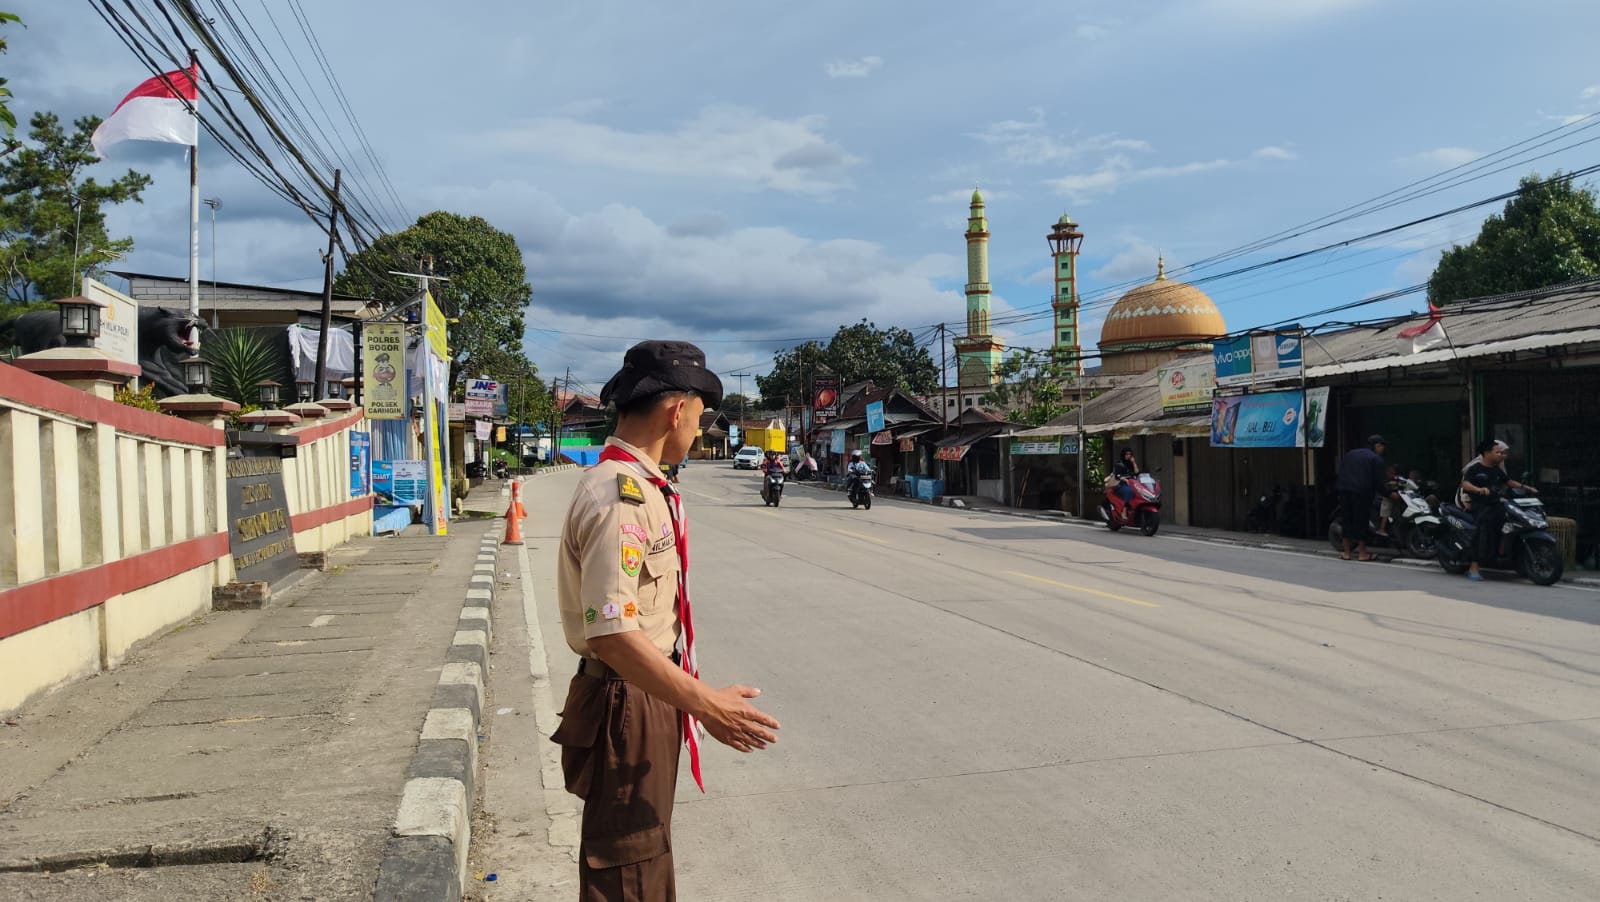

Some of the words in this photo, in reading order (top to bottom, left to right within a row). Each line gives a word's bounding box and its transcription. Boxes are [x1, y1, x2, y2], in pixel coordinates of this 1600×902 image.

[367, 336, 400, 344] POLRES
[369, 344, 399, 352] BOGOR
[1215, 352, 1232, 364] vivo
[472, 380, 497, 391] JNE
[1262, 421, 1275, 432] BELI
